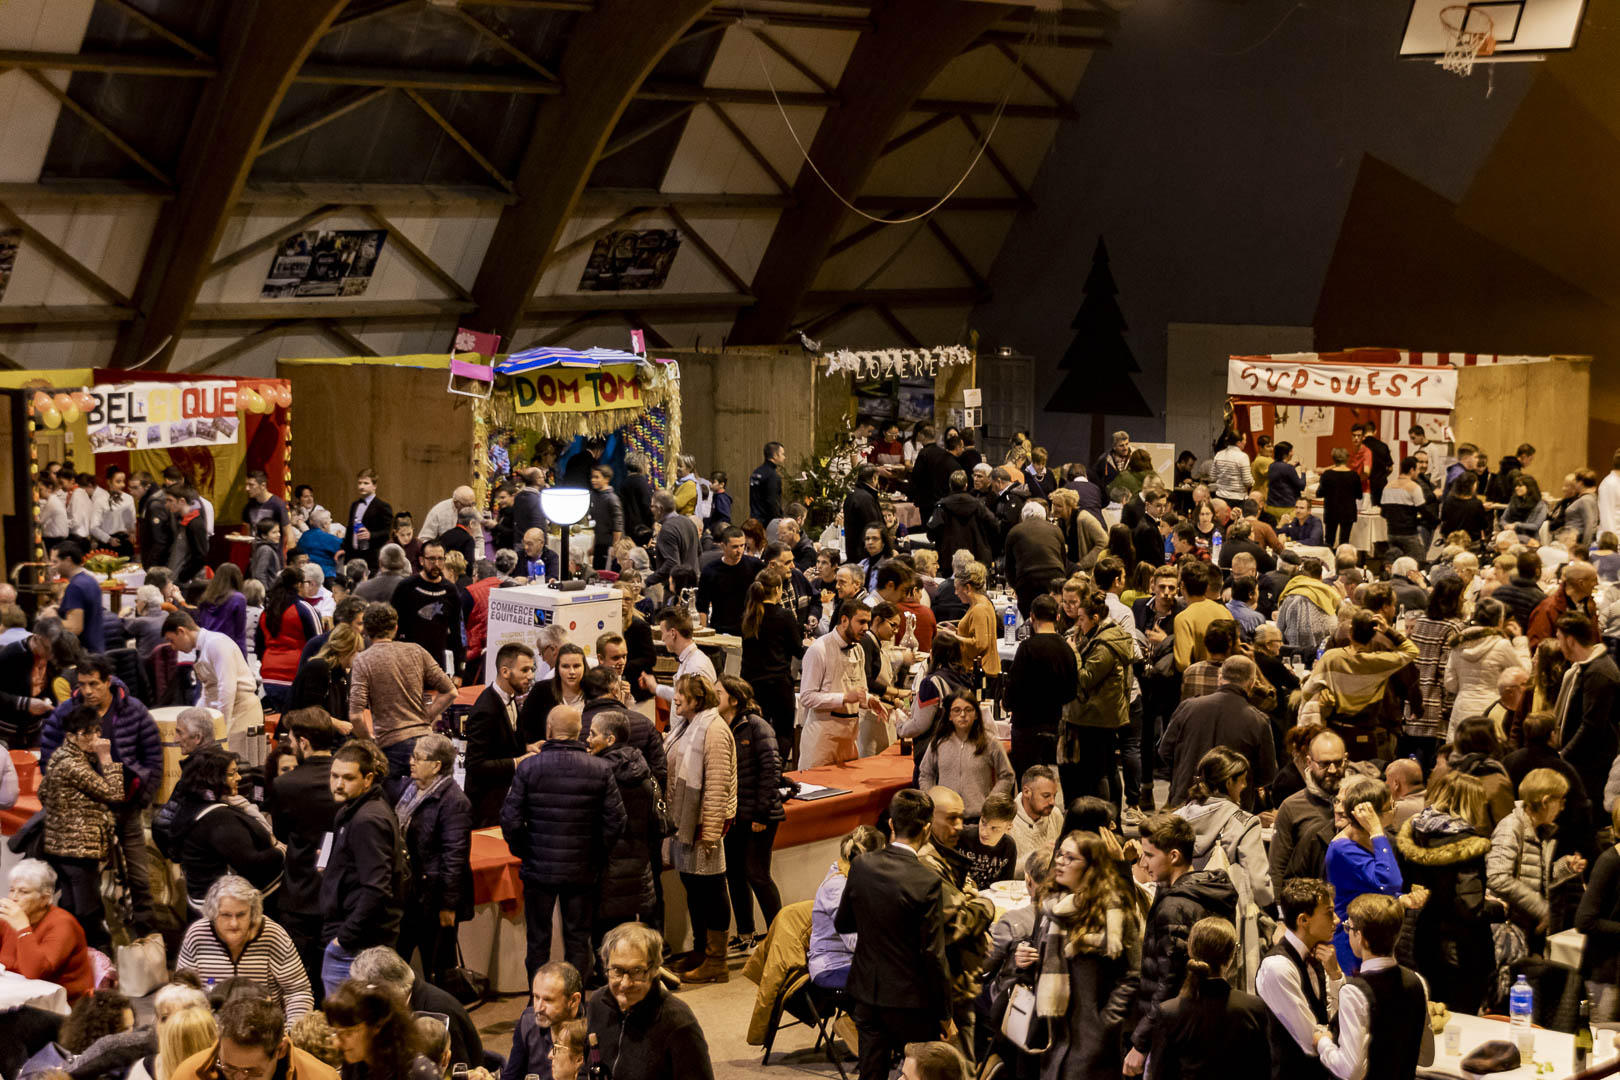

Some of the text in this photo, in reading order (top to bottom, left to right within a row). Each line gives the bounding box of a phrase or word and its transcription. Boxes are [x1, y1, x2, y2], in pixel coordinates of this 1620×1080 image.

[515, 373, 640, 406] DOM TOM
[1240, 366, 1429, 397] SUD-OUEST
[86, 387, 238, 425] BELGIQUE
[491, 601, 533, 616] COMMERCE
[491, 611, 532, 625] EQUITABLE
